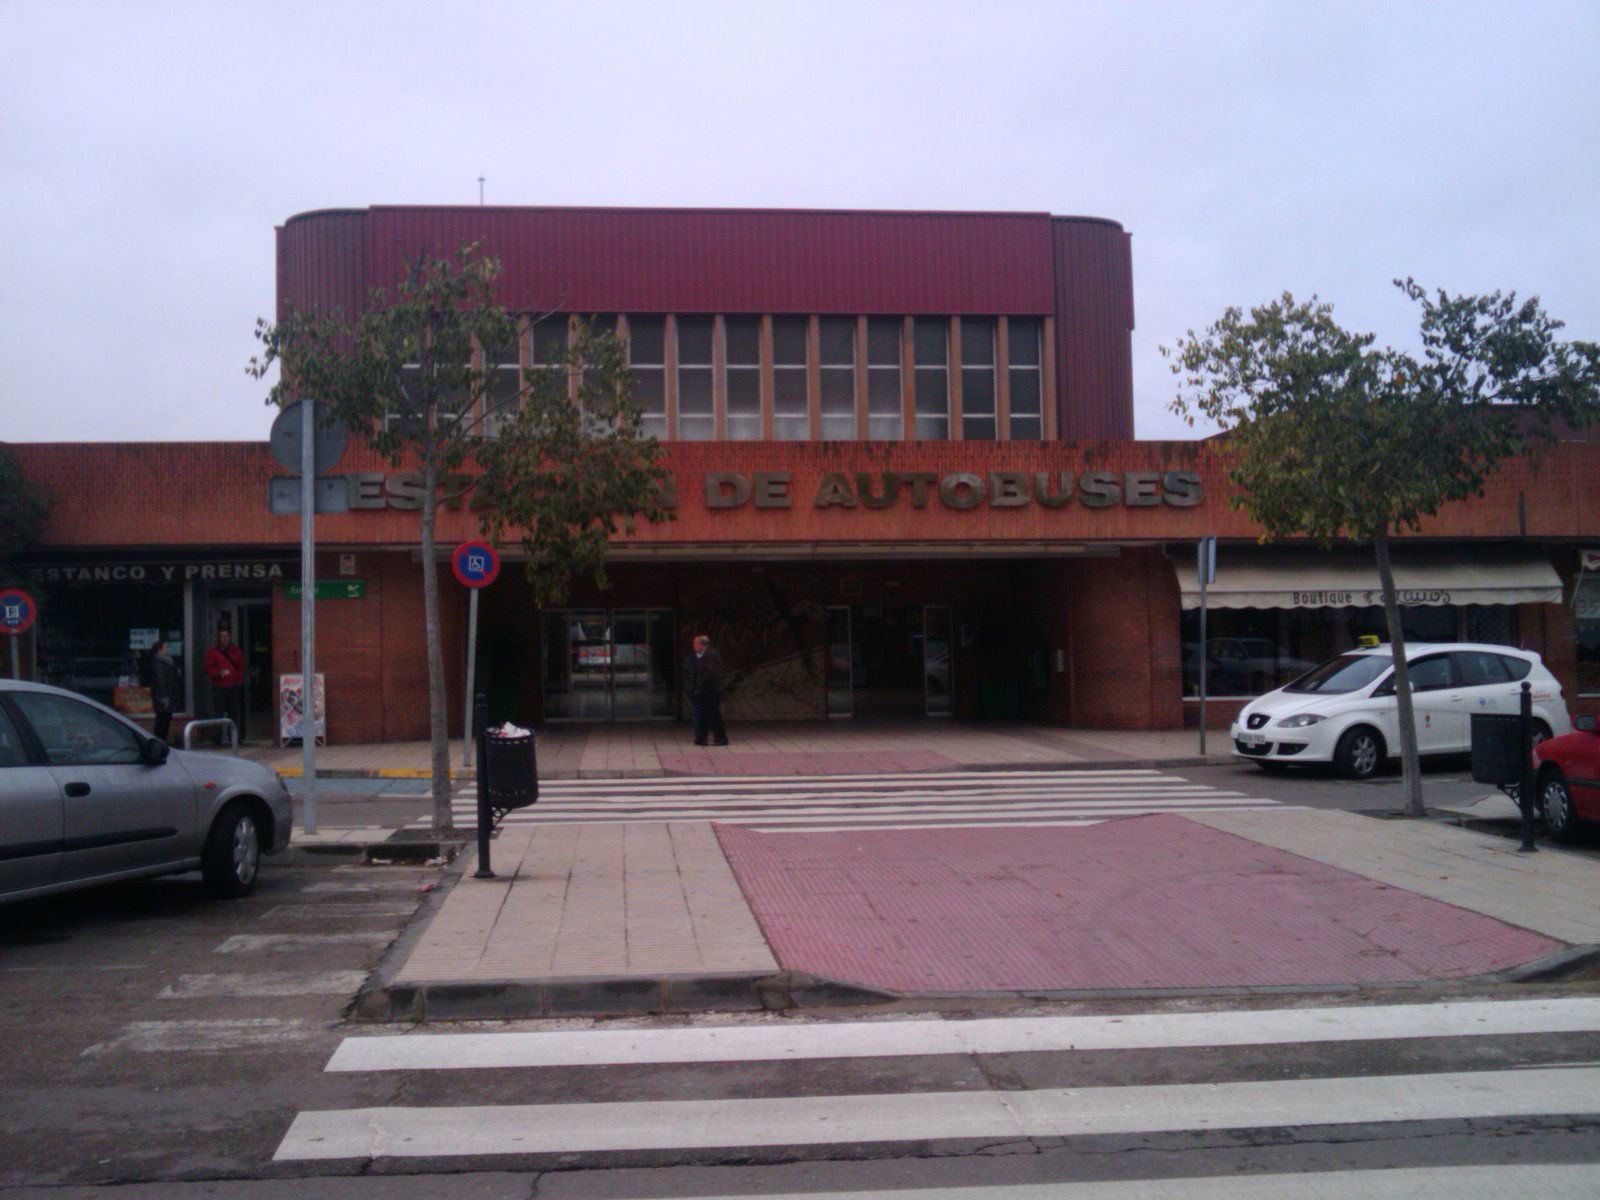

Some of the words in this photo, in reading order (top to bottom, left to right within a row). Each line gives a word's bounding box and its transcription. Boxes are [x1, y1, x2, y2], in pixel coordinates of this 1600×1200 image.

[347, 472, 676, 511] ESTN
[705, 471, 793, 509] DE
[814, 471, 1205, 510] AUTOBUSES
[33, 566, 146, 582] ESTANCO
[160, 565, 177, 580] Y
[185, 563, 284, 580] PRENSA
[1293, 591, 1352, 605] Boutique
